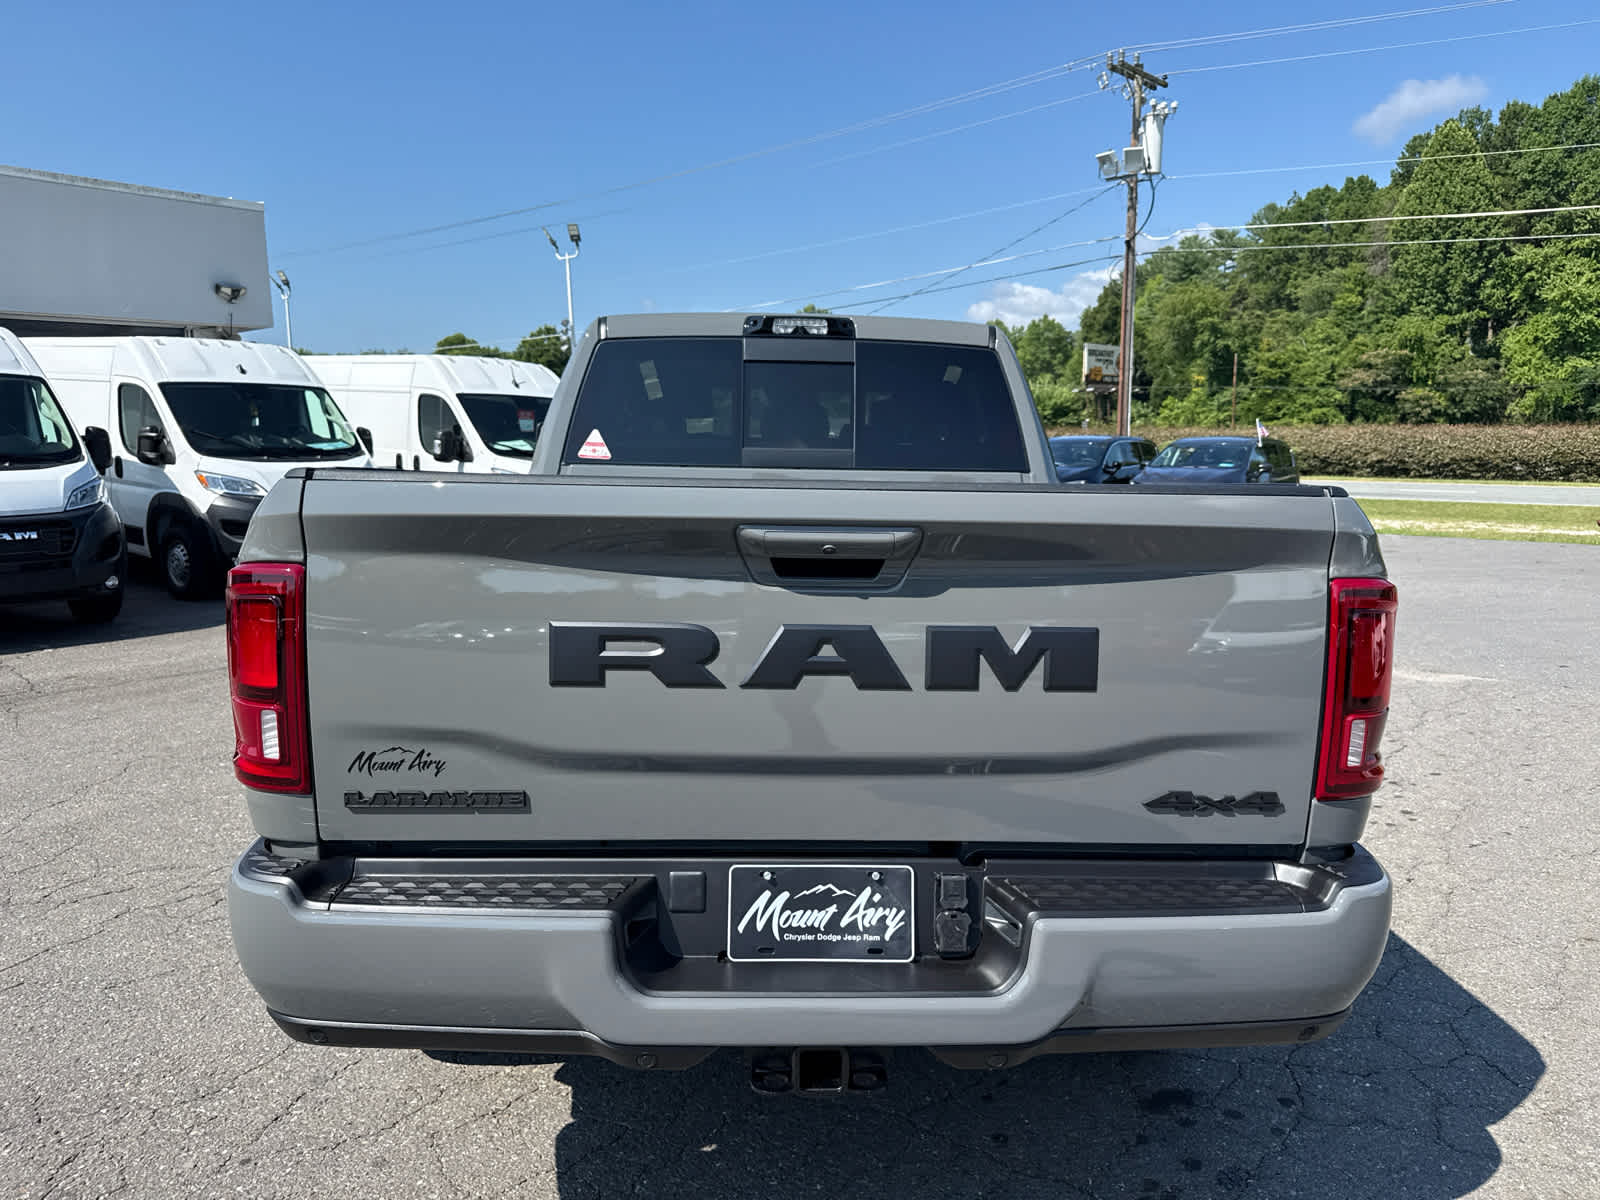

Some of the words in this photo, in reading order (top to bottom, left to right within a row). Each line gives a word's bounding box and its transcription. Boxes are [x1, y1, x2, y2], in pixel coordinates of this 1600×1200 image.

[549, 620, 1100, 693] RAM
[348, 750, 406, 777] Mount
[408, 749, 446, 777] Airy
[344, 791, 530, 812] LARAMIE
[737, 889, 838, 940] Mount
[840, 886, 906, 941] Airy
[783, 933, 816, 942] Chrysler
[817, 933, 841, 942] Dodge
[843, 933, 861, 942] Jeep
[863, 933, 881, 941] Ram
